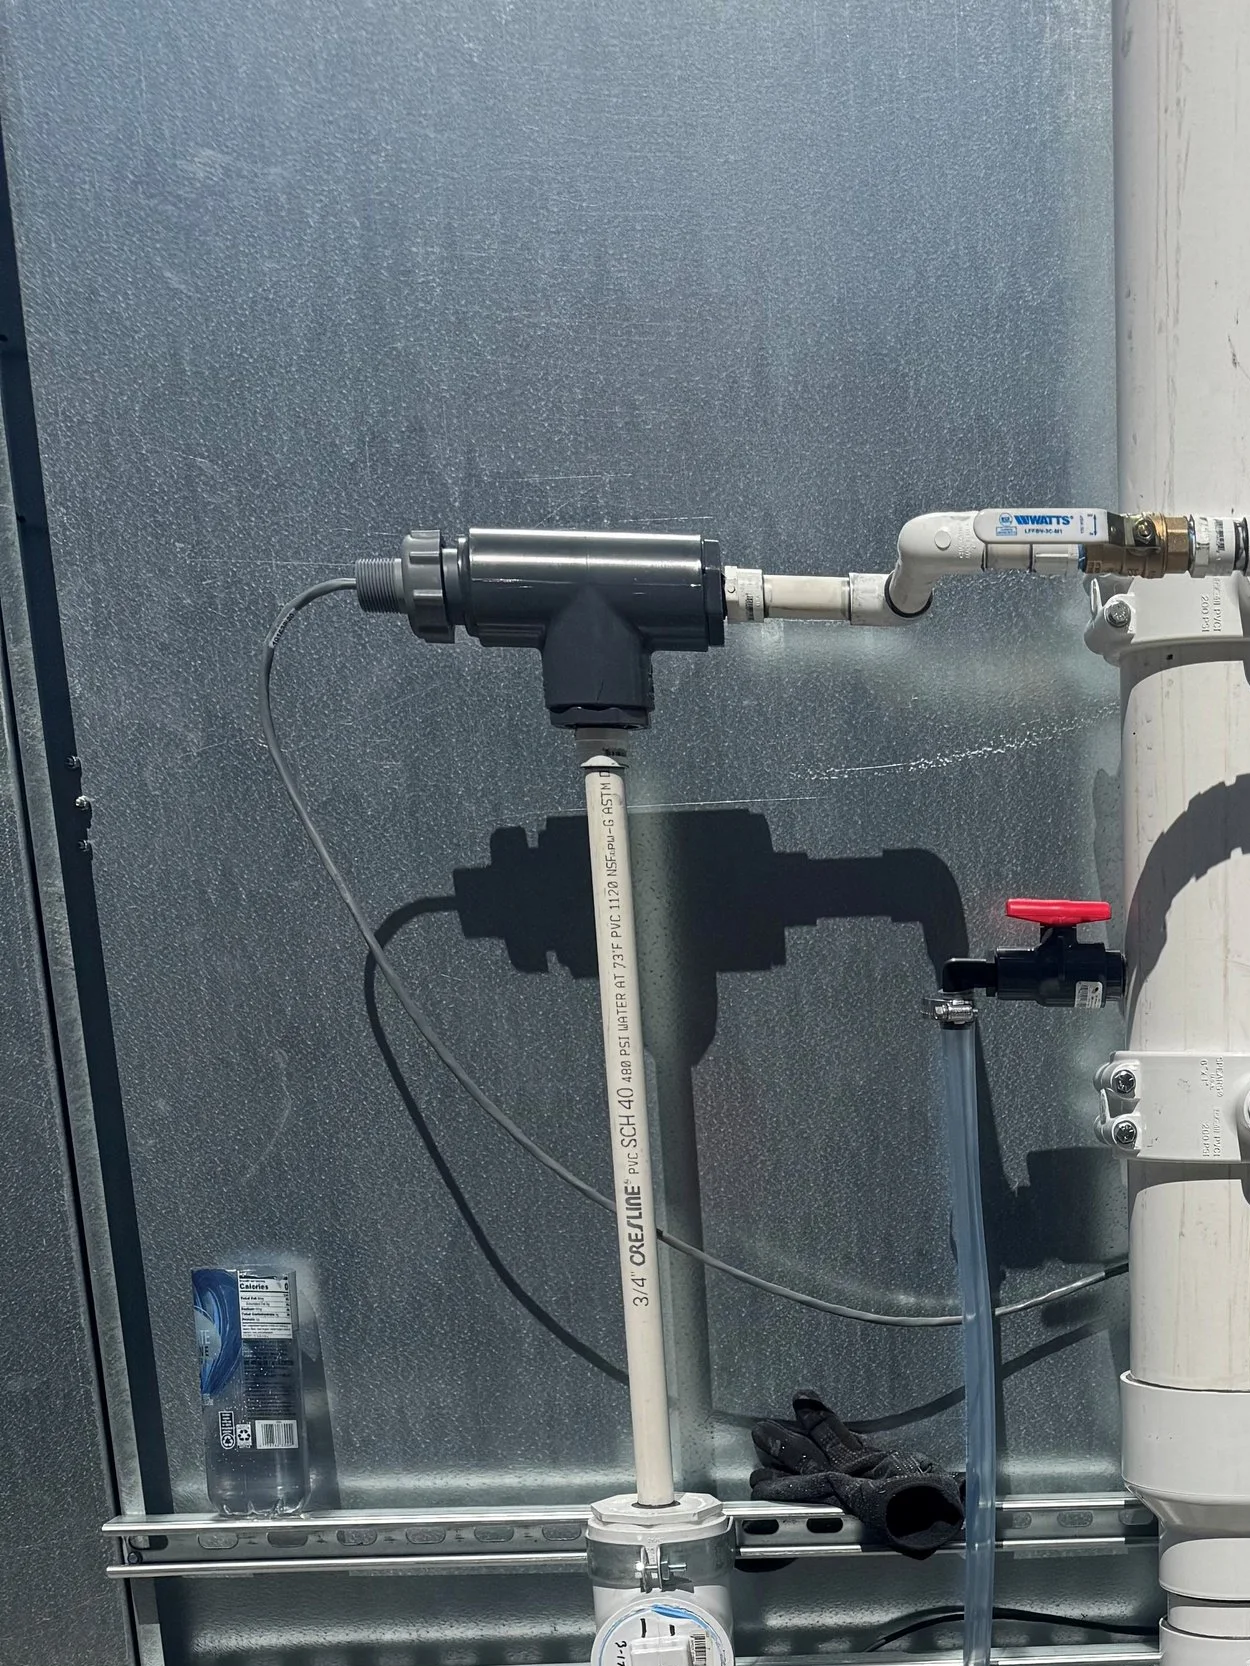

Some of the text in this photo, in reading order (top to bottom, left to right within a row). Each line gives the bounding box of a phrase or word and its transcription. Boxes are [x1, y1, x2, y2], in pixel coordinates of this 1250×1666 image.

[1016, 514, 1071, 525] WATTS
[601, 782, 613, 814] ASTM
[607, 881, 620, 910] 1120
[611, 914, 621, 938] PVC
[614, 975, 625, 989] AT
[616, 991, 630, 1034] WATER
[620, 1036, 631, 1057] PSI
[620, 1061, 632, 1083] 480
[618, 1088, 634, 1110] 40
[620, 1115, 636, 1149] SCH
[628, 1152, 639, 1174] PVC
